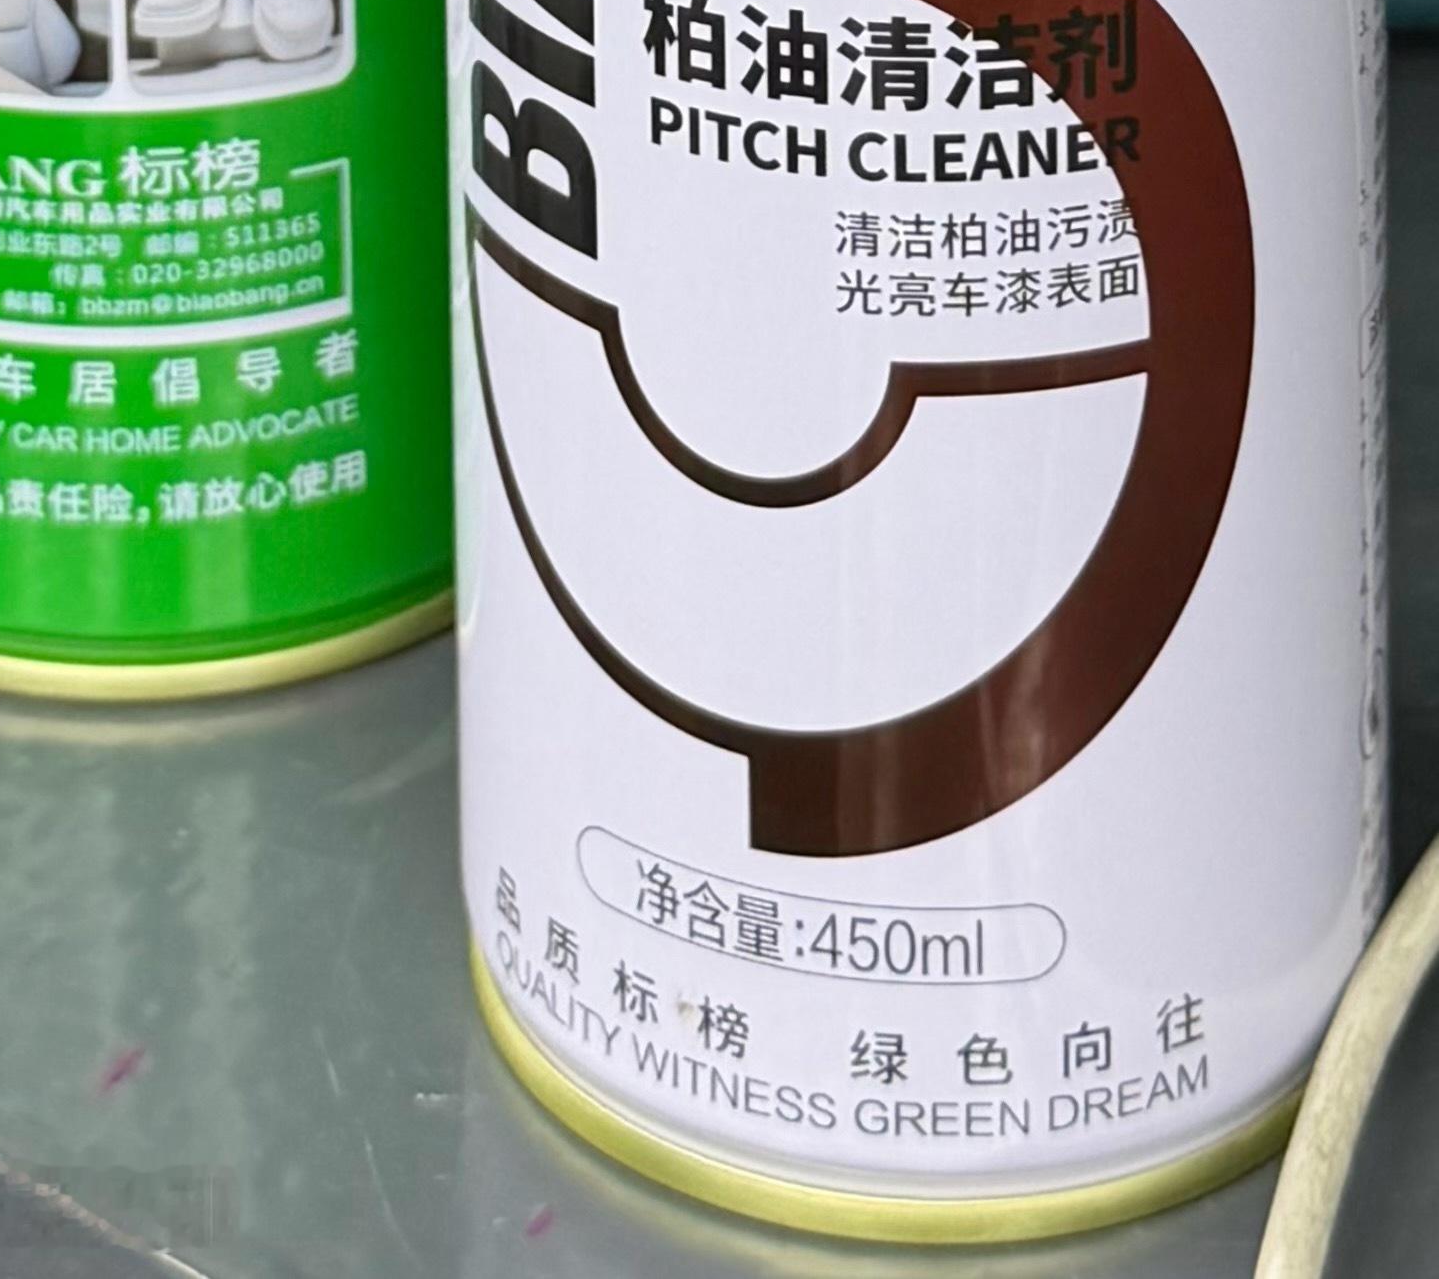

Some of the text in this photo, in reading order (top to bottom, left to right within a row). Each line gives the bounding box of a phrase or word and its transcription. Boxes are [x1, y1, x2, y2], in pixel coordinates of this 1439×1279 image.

[119, 138, 260, 197] 标榜
[650, 97, 1141, 184] PITCH CLEANER
[833, 198, 1140, 260] 清洁柏油污渍
[835, 253, 1141, 318] 光亮车漆表面
[8, 421, 77, 453] CAR
[87, 429, 181, 455] HOME
[188, 393, 360, 452] ADVOCATE
[634, 859, 986, 979] 净含量:450ml
[495, 865, 1207, 1089] 品质标榜 绿色向往
[494, 928, 1211, 1139] QUALITY WITNESS GREEN DREAM
